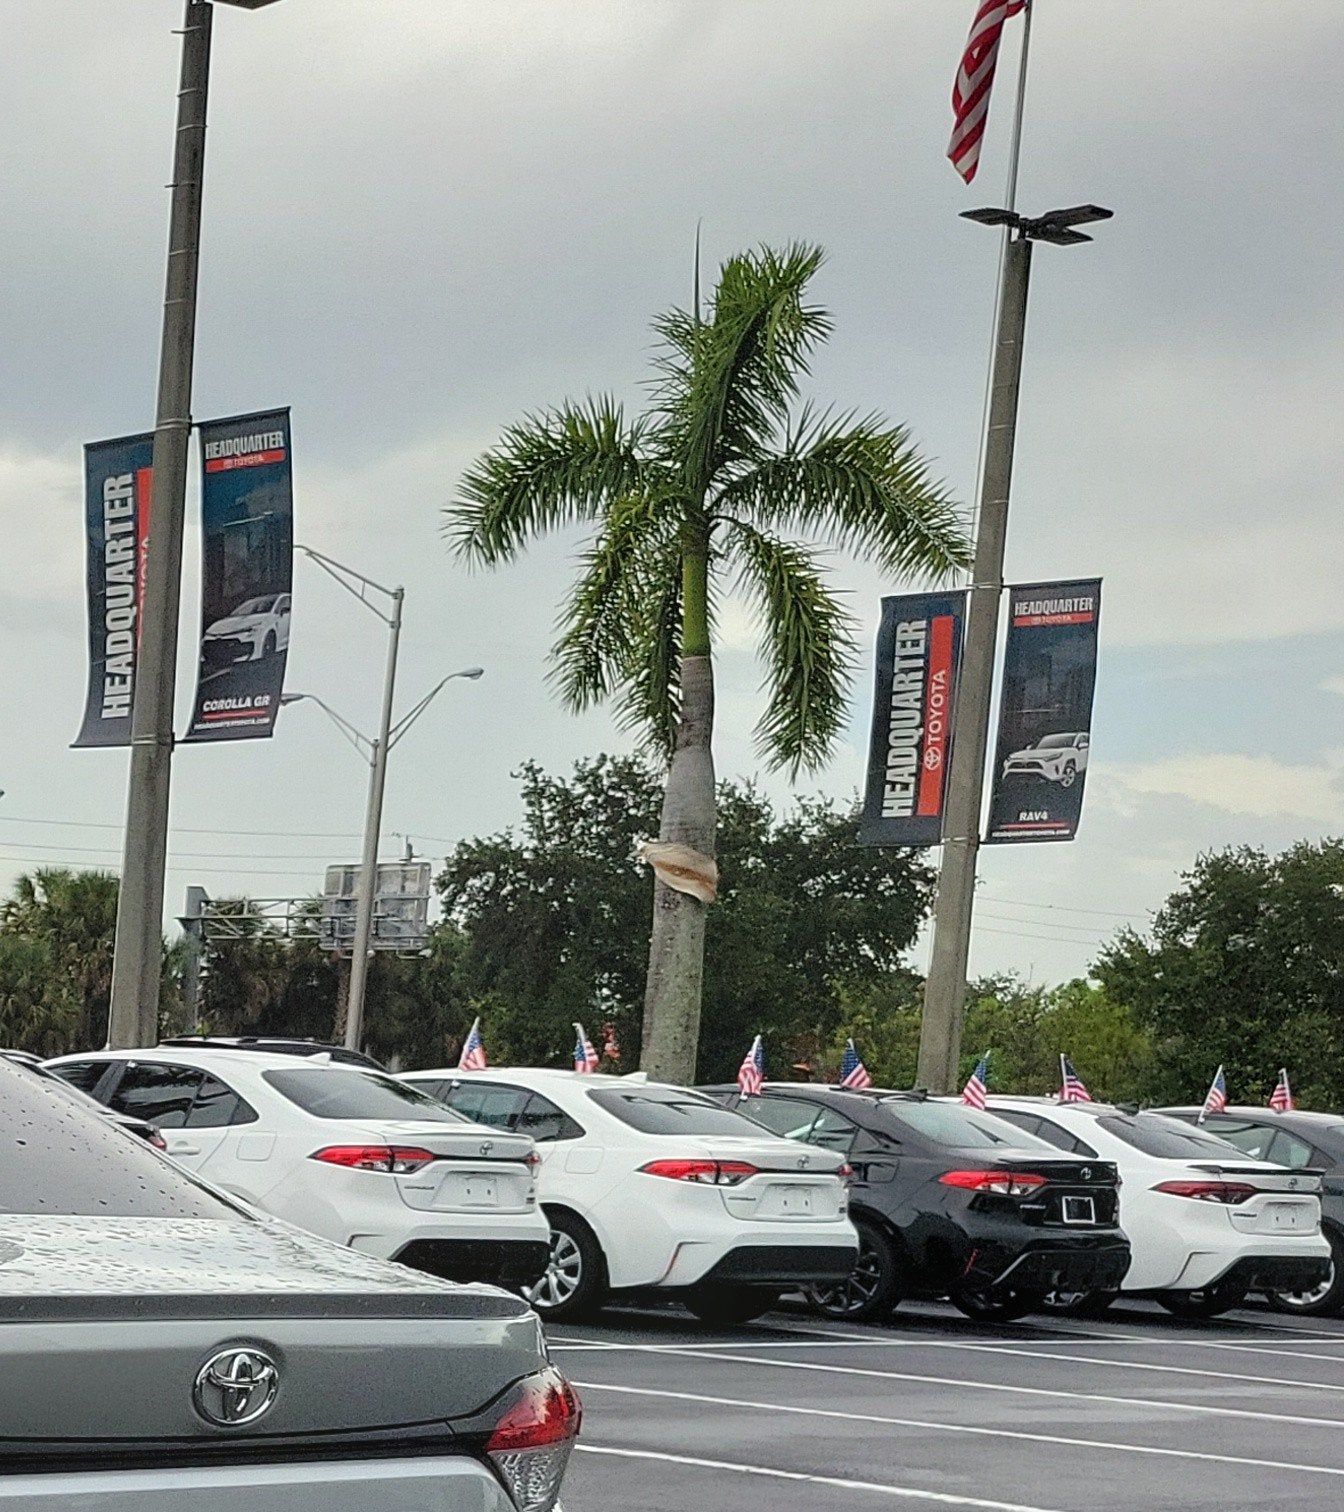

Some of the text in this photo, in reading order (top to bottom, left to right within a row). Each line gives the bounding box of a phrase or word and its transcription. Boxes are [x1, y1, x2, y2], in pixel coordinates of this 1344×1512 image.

[205, 431, 284, 459] HEADQUARTER
[102, 473, 137, 719] HEADQUARTER
[1015, 597, 1093, 616] HEADQUARTER
[203, 695, 270, 711] COROLLA GR
[928, 669, 947, 746] TOYOTA
[882, 619, 927, 818] HEADQUARTER
[1019, 811, 1049, 821] RAV4
